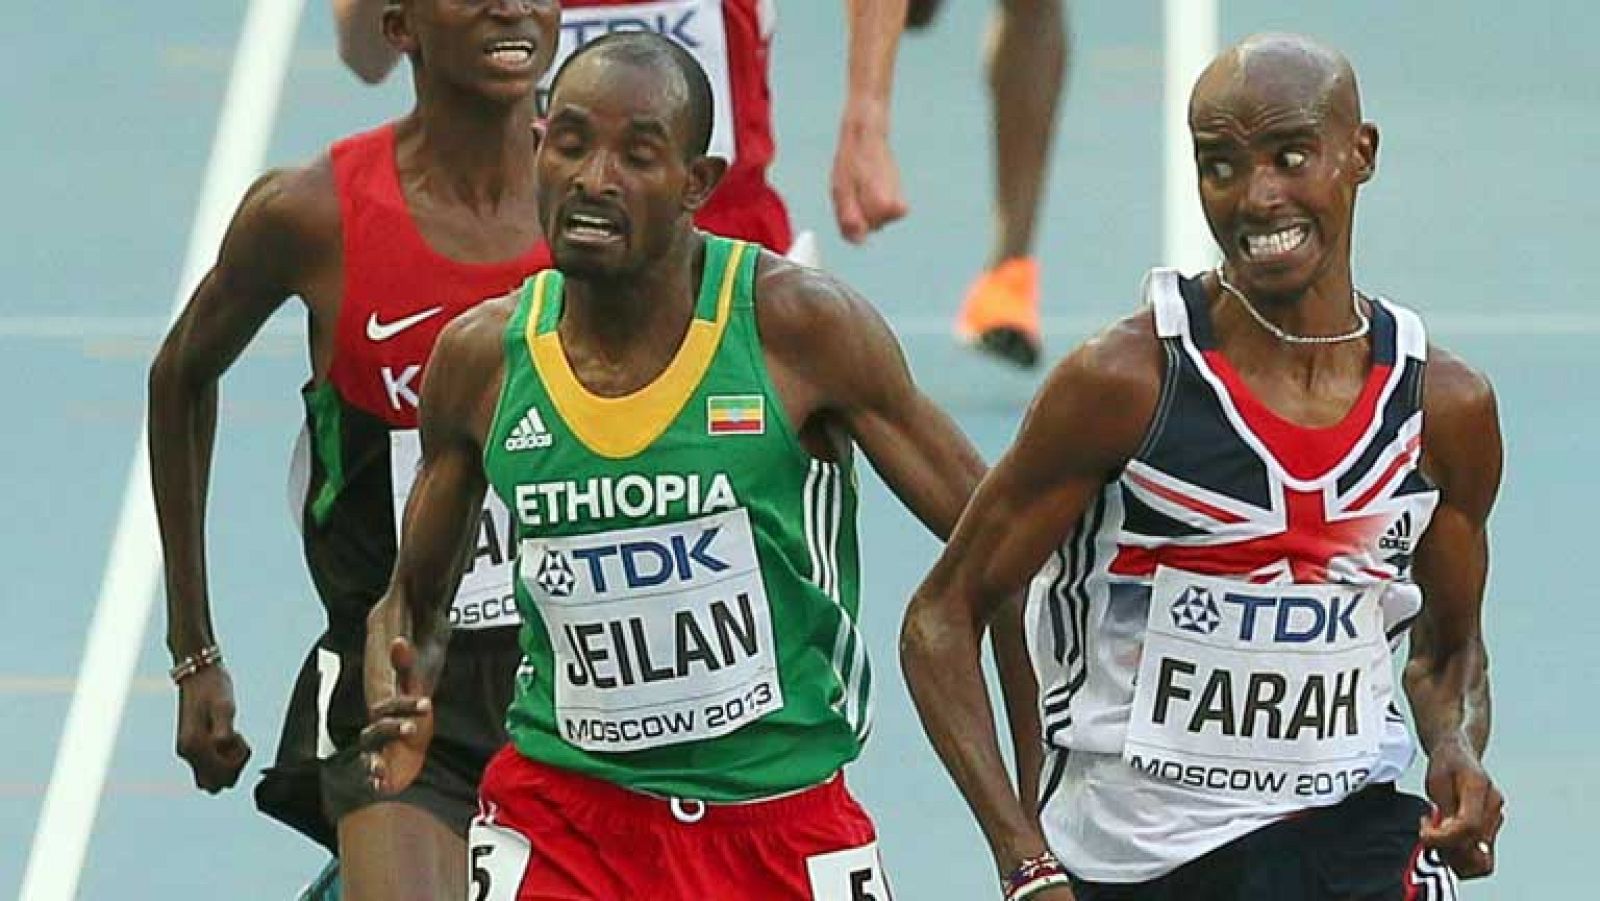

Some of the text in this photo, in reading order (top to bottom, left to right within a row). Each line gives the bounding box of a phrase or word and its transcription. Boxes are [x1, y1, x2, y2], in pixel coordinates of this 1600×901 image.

[515, 473, 738, 525] ETHIOPIA
[573, 526, 731, 593] TDK
[564, 592, 758, 689] JEILAN
[1224, 594, 1365, 643] TDK
[566, 682, 772, 743] MOSCOW 2013
[1152, 657, 1360, 740] FARAH
[1130, 755, 1289, 794] MOSCOW
